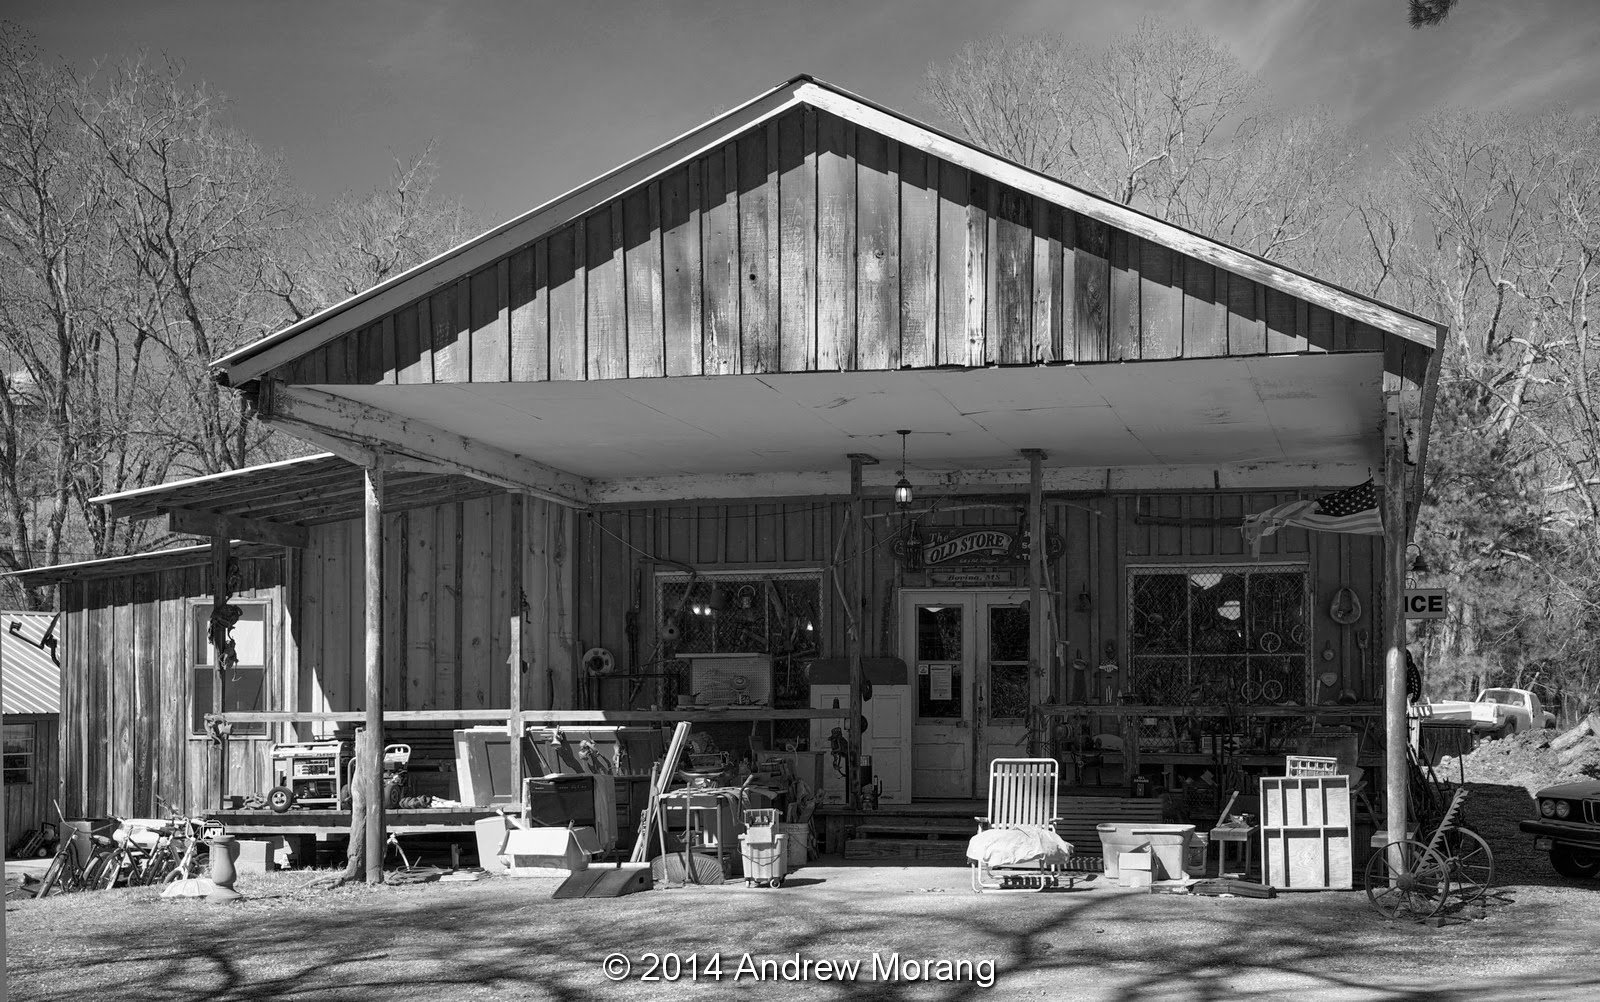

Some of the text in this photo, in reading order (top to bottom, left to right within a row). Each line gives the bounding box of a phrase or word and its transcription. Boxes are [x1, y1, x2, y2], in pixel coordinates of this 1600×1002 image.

[929, 532, 949, 543] The
[930, 533, 1005, 563] OLD STORE
[1404, 595, 1443, 613] ICE
[204, 827, 222, 839] ADT
